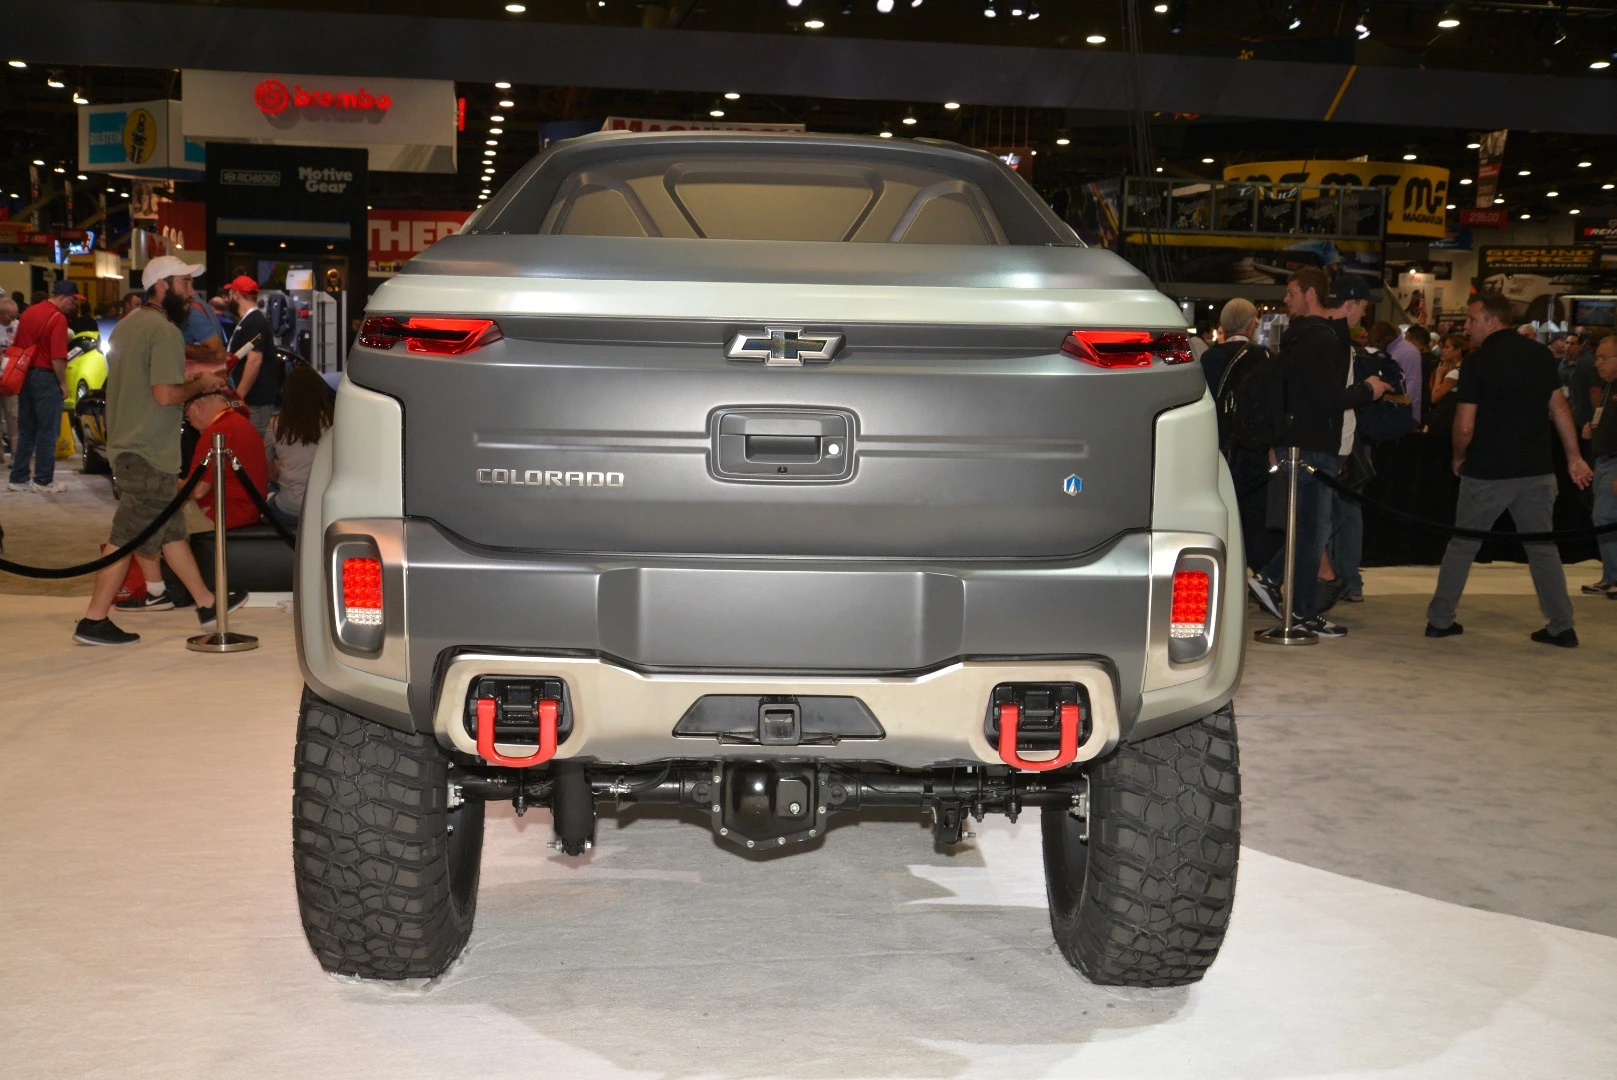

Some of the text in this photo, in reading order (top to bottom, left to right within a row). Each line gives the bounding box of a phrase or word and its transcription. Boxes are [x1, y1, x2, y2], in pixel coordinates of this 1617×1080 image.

[294, 86, 392, 110] brembo
[89, 130, 123, 146] BILSTEIN
[237, 173, 278, 184] RICHMOND
[298, 166, 353, 181] Motive
[305, 179, 347, 193] Gear
[475, 468, 624, 487] COLORADO
